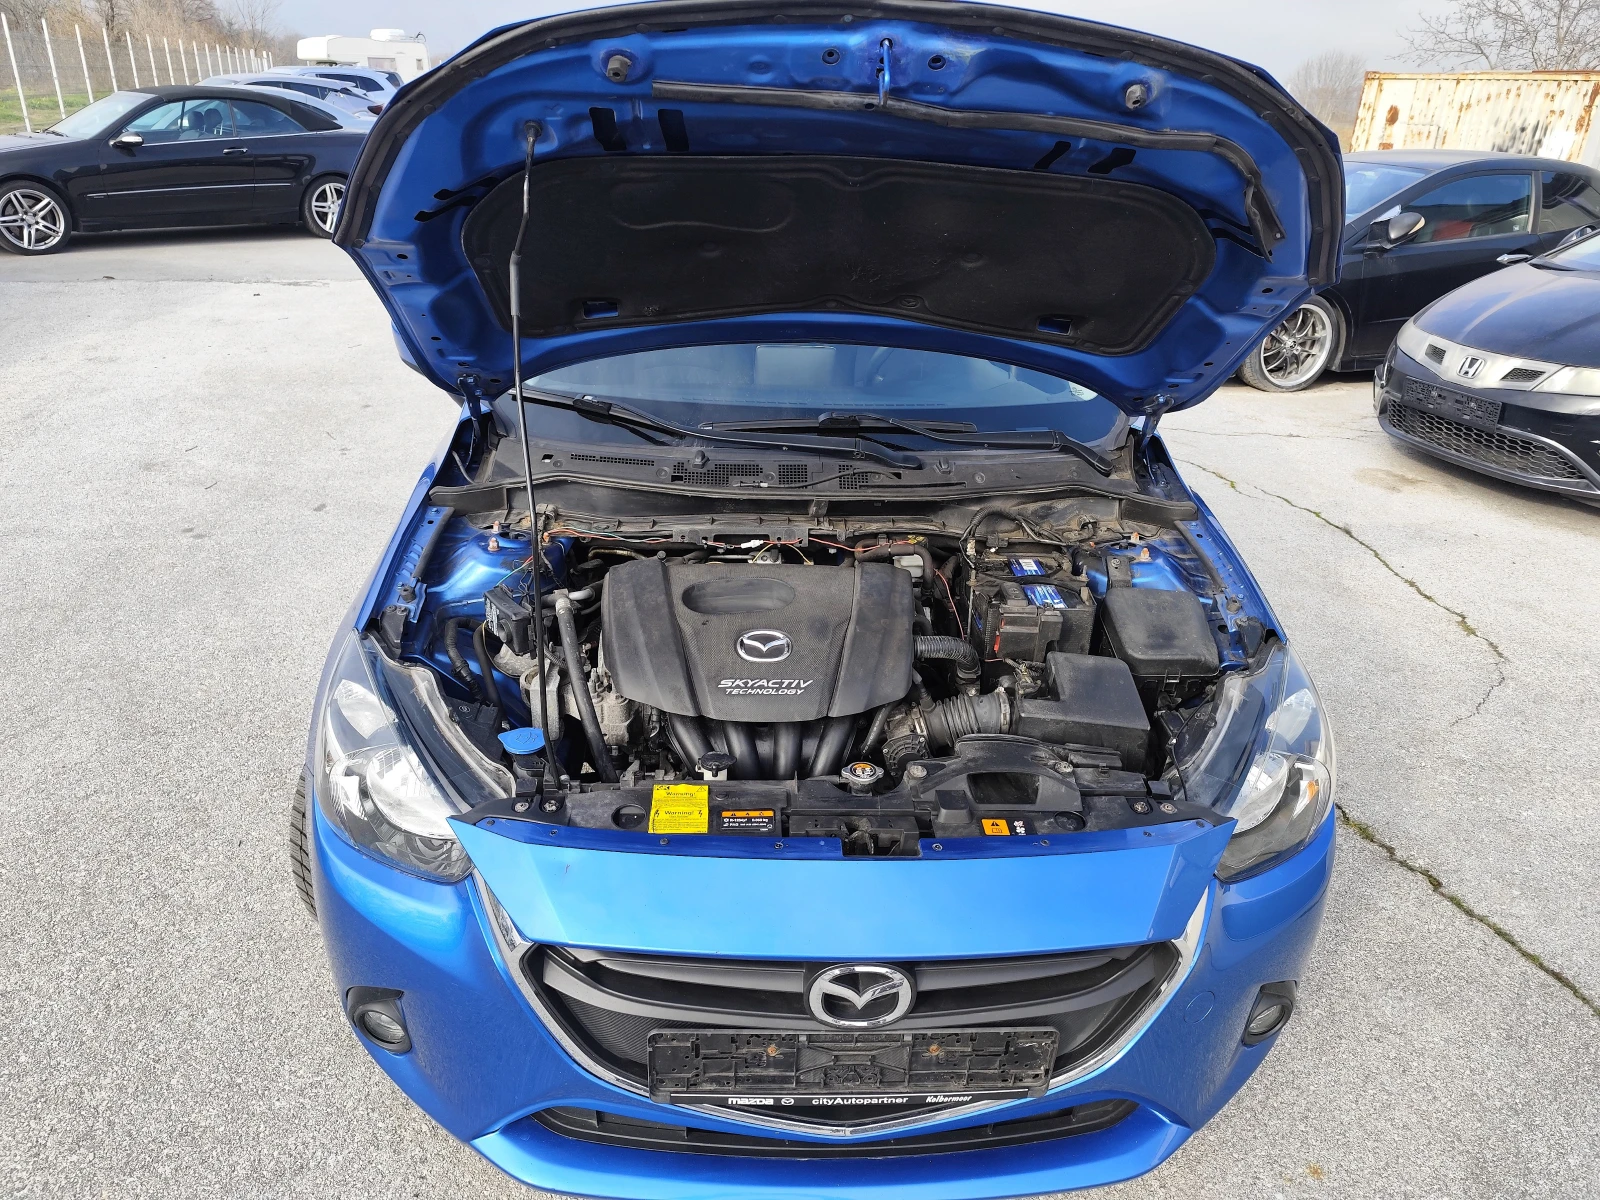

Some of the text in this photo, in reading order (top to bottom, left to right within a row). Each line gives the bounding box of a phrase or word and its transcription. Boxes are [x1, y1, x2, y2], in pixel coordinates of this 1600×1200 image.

[717, 679, 813, 688] SKYACTIV
[728, 1097, 774, 1105] mazda
[811, 1097, 909, 1106] cityAutopartner
